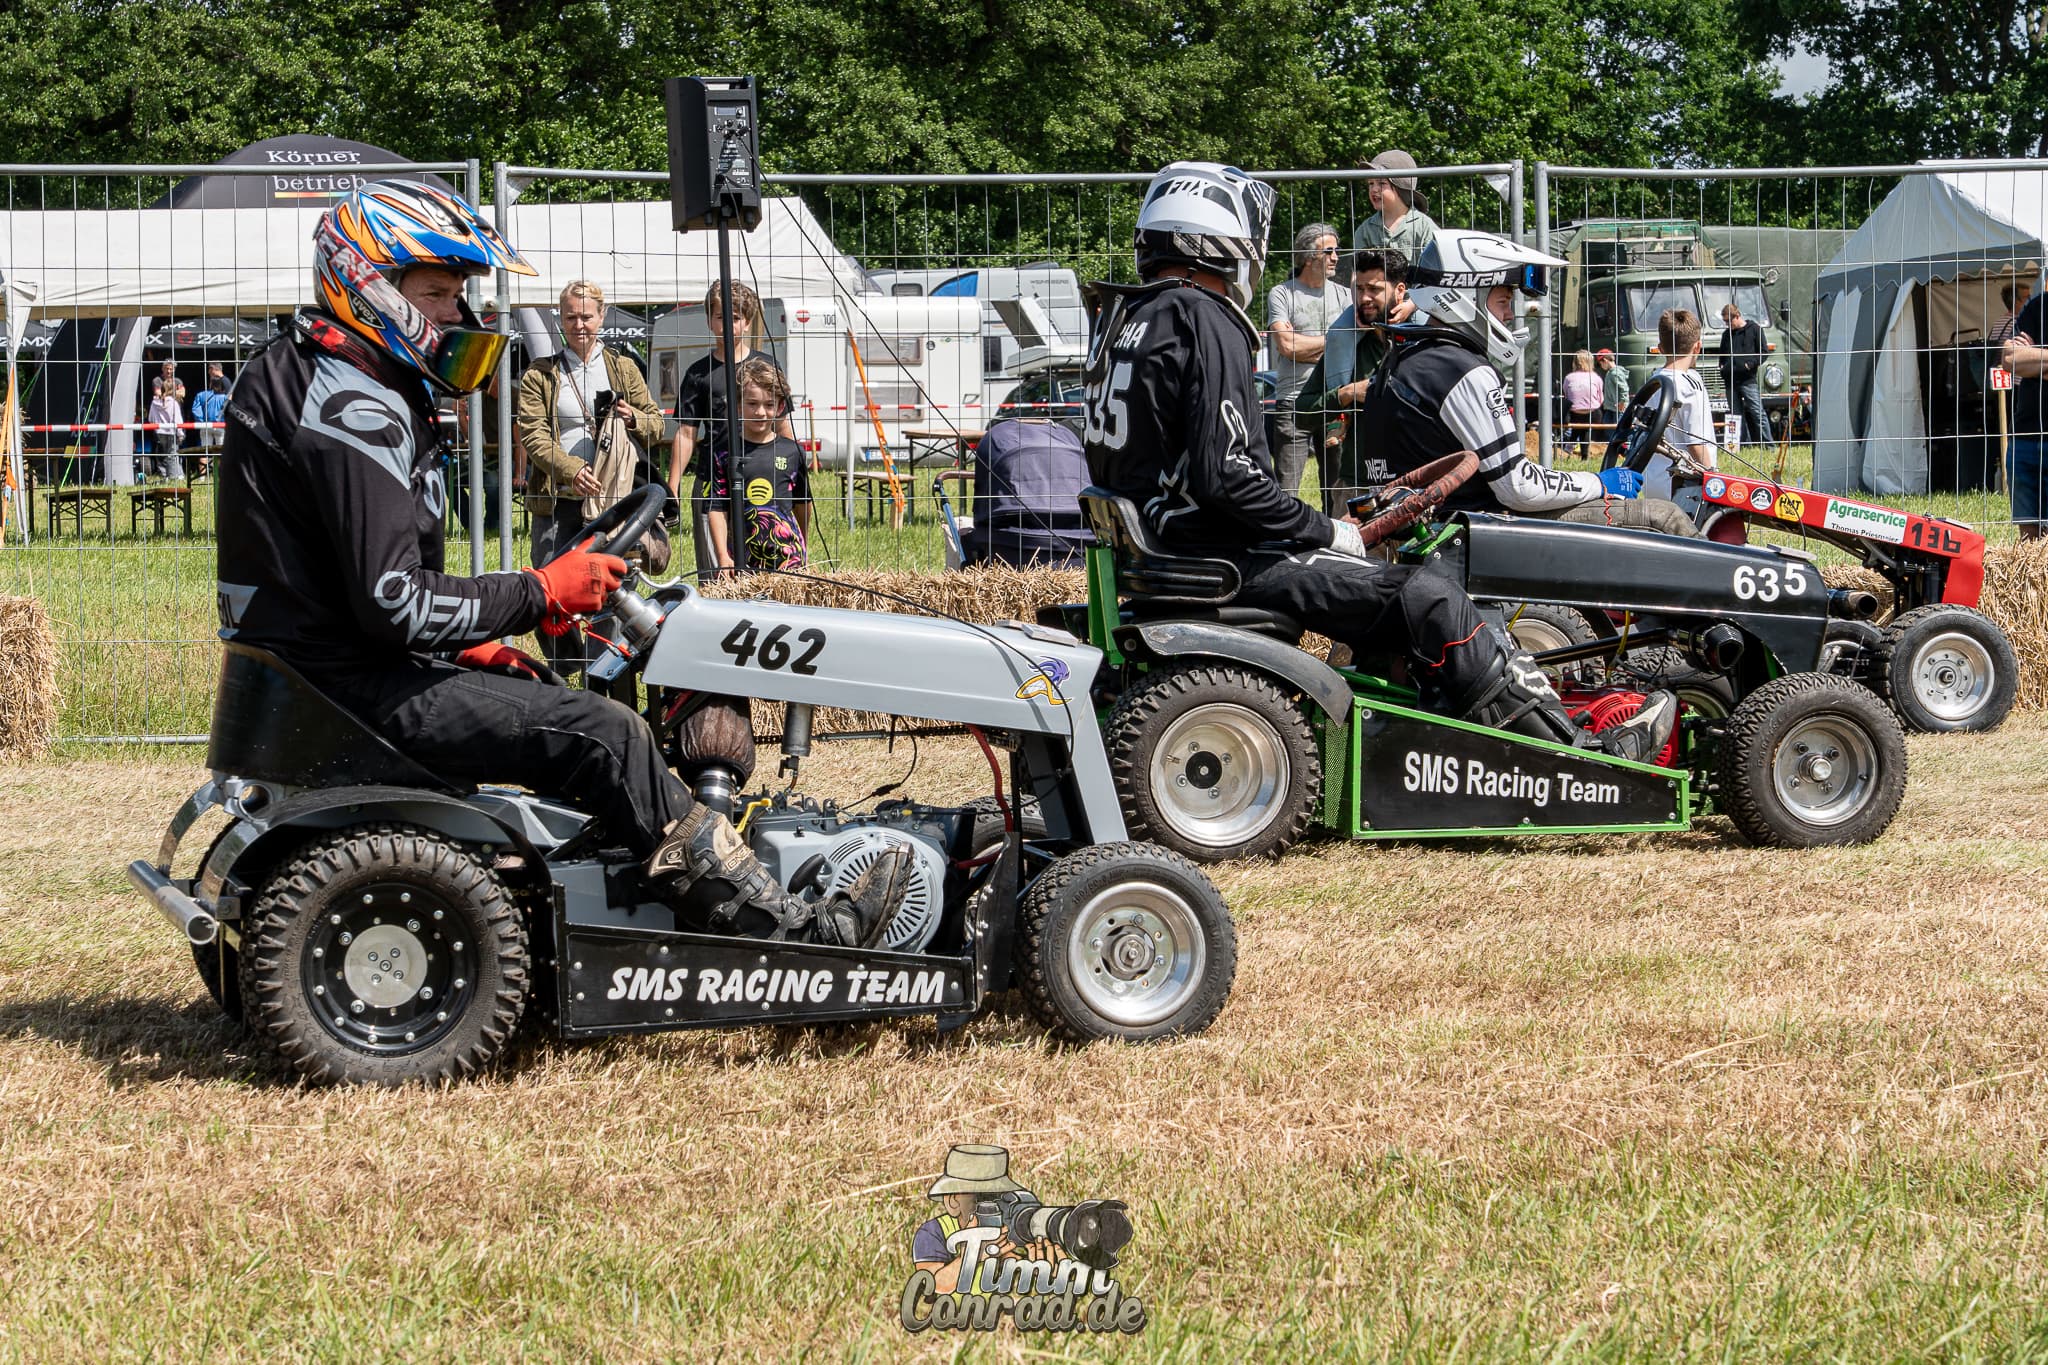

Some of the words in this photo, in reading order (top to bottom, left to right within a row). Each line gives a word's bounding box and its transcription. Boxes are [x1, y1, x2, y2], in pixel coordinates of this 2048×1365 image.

[265, 150, 361, 163] Körner
[272, 174, 367, 191] betrieb
[1440, 270, 1508, 287] RAVEN
[351, 296, 377, 324] uvex
[823, 313, 836, 326] 100
[197, 334, 255, 345] 24MX
[1829, 500, 1906, 528] Agrarservice
[1831, 522, 1860, 536] Thomas
[1733, 562, 1808, 602] 635
[720, 618, 827, 676] 462
[1404, 751, 1459, 794] SMS
[1466, 760, 1550, 807] Racing
[1557, 772, 1620, 804] Team
[607, 967, 688, 1001] SMS
[696, 969, 834, 1004] RACING
[846, 970, 946, 1004] TEAM
